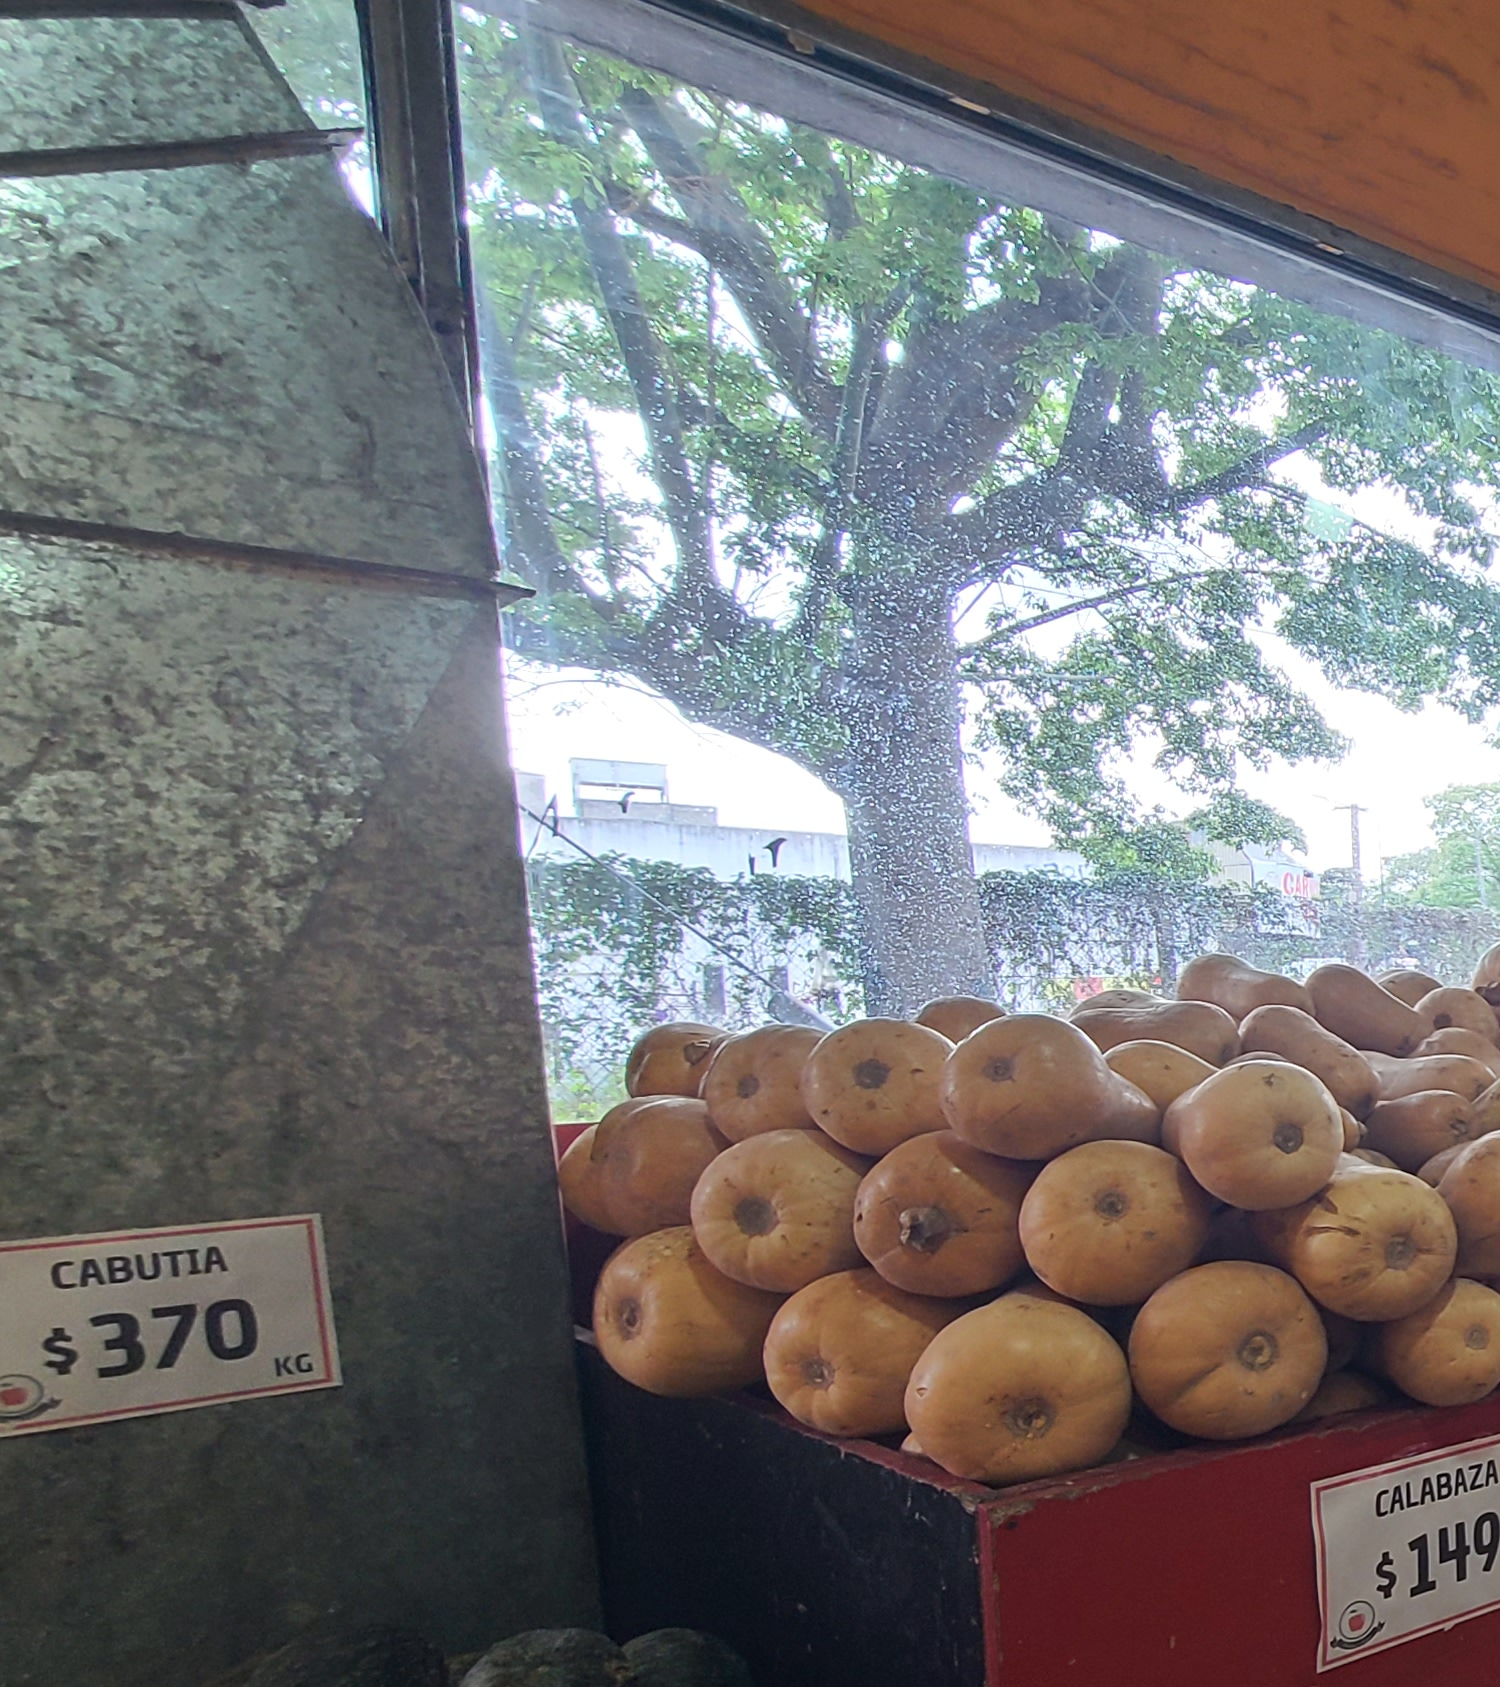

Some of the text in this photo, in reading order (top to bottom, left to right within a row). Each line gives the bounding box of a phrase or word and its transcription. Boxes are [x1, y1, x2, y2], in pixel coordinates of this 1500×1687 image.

[1282, 871, 1319, 898] CAR
[50, 1246, 229, 1290] CABUTIA
[41, 1298, 259, 1379] $370
[274, 1353, 314, 1377] KG
[1375, 1459, 1499, 1518] CALABAZA
[1375, 1511, 1500, 1600] $149
